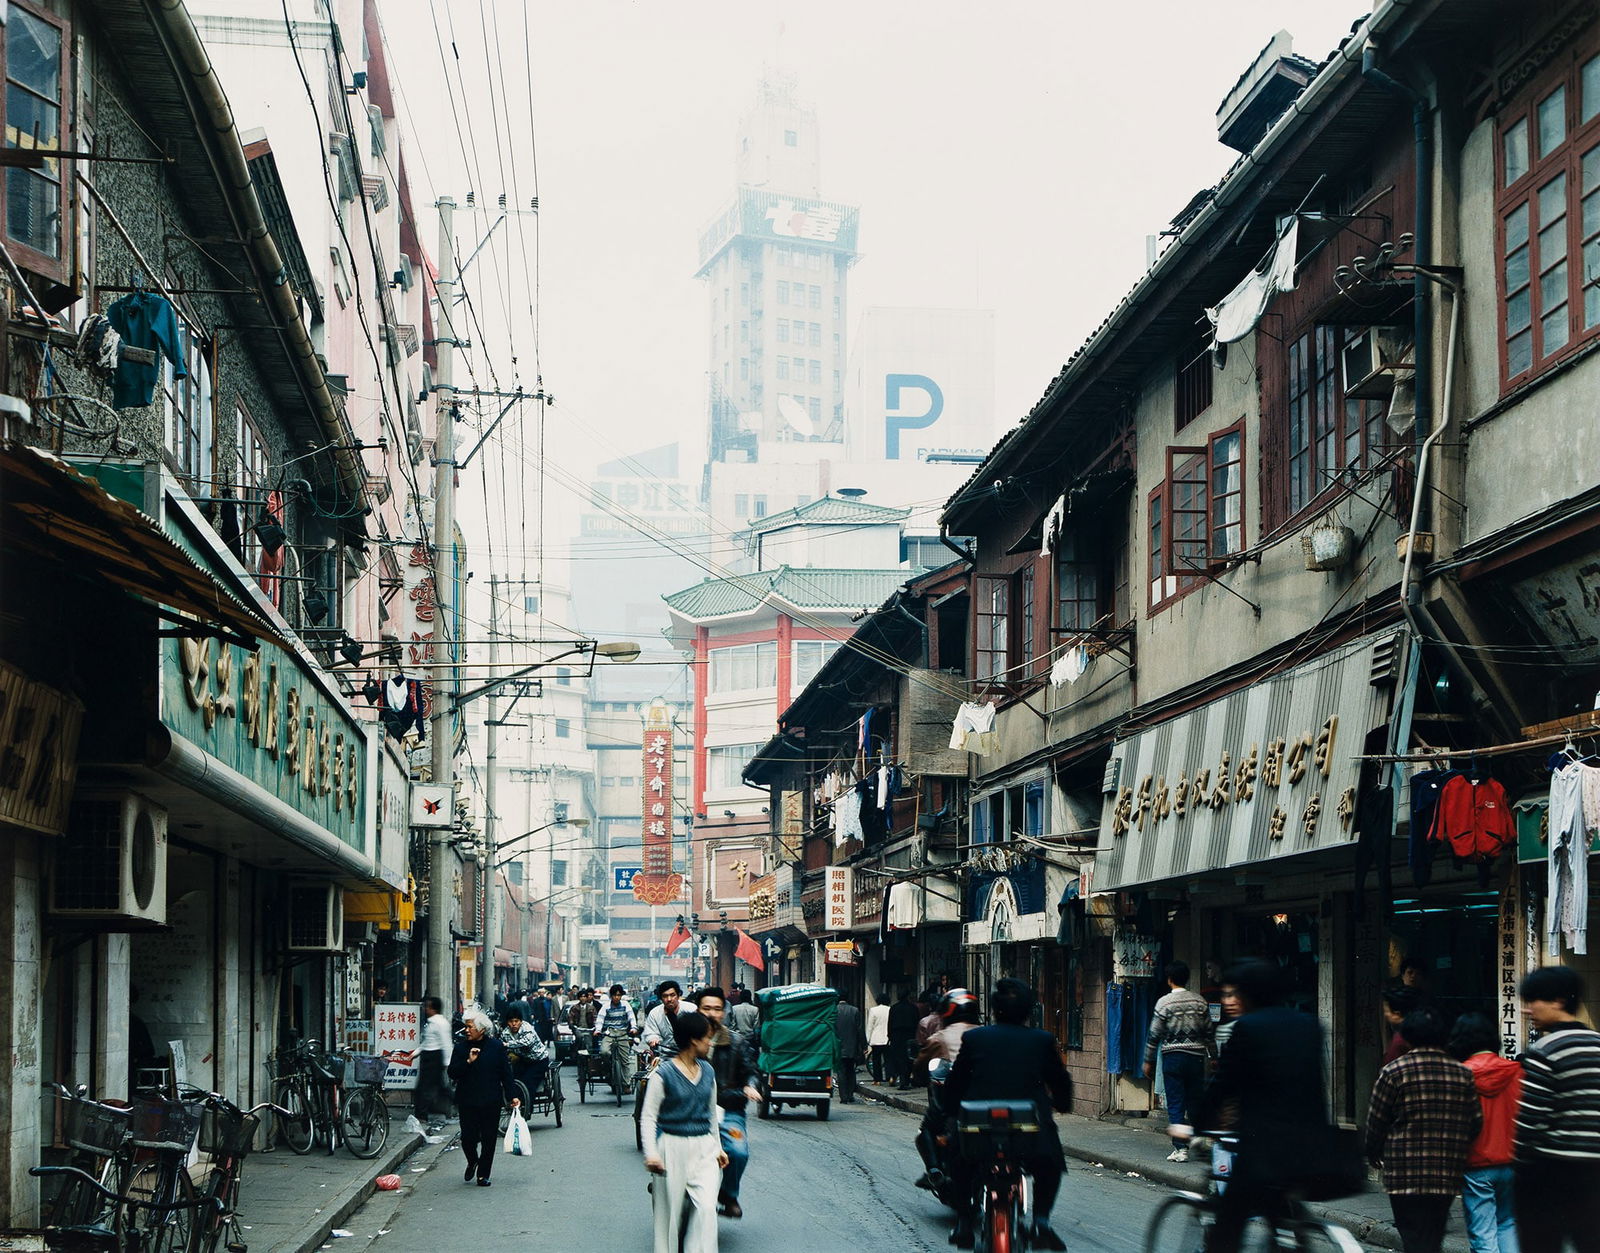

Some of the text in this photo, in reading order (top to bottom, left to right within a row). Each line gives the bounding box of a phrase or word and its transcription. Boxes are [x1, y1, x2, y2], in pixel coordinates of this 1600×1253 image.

[885, 373, 944, 460] P
[831, 870, 846, 926] 照相机医院
[384, 1068, 418, 1078] 威啤酒
